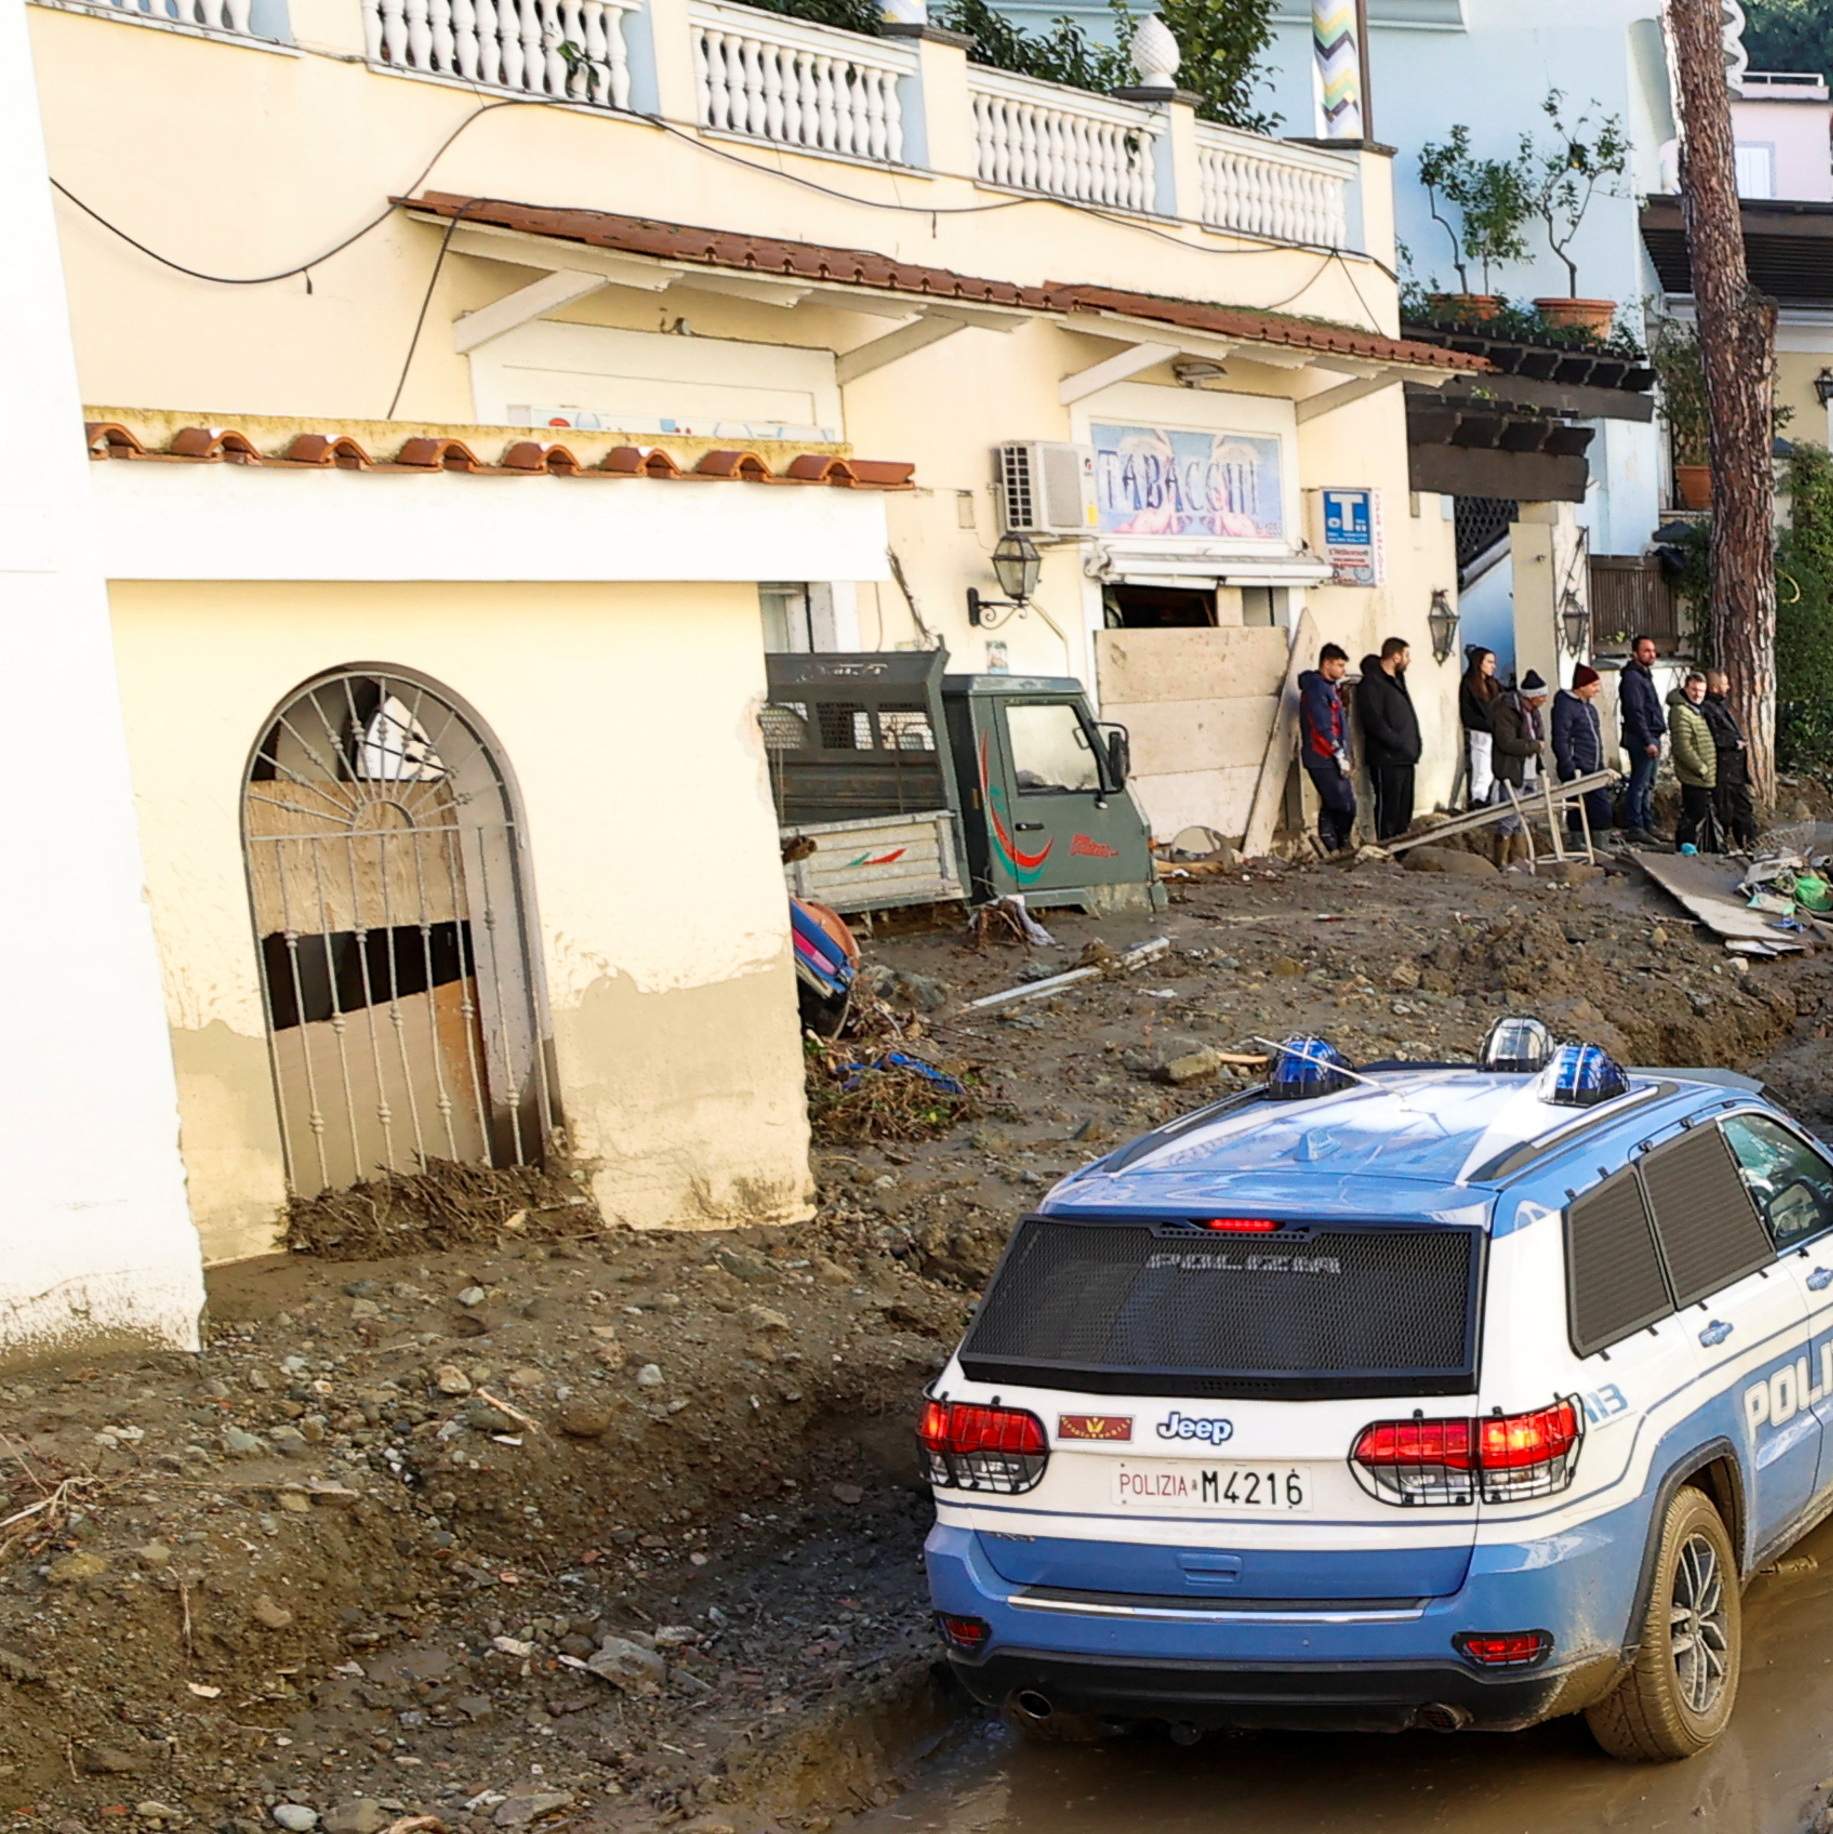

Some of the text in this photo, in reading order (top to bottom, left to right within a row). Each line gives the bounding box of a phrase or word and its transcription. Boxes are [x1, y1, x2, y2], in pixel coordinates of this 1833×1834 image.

[1098, 449, 1258, 516] TABACCHI
[1329, 493, 1364, 532] T
[1146, 1253, 1341, 1275] POLIZIA
[1157, 1411, 1233, 1445] Jeep
[1119, 1469, 1304, 1506] POLIZIA M4216
